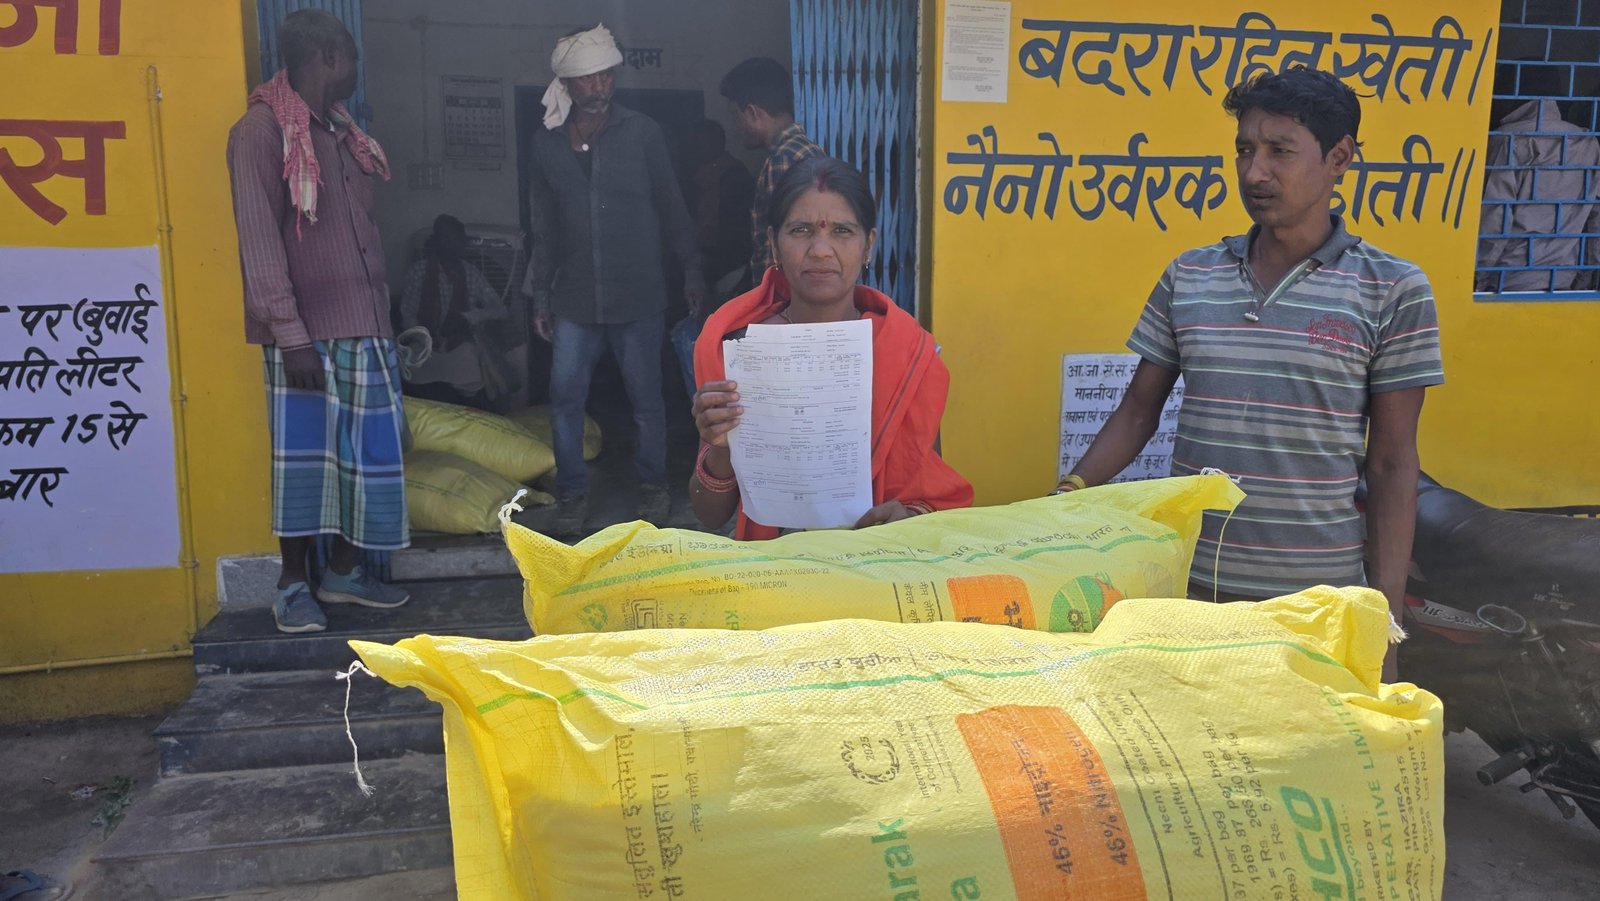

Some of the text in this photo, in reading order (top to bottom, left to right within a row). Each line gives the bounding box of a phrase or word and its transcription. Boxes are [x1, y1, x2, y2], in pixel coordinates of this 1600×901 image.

[1018, 18, 1195, 96] बदरा
[943, 125, 1073, 221] नैनो
[1069, 132, 1227, 231] उर्वरक
[17, 303, 73, 342] पर
[55, 346, 145, 396] लीटर
[61, 413, 104, 444] 15
[107, 400, 148, 450] से
[858, 735, 876, 762] 2025
[1202, 750, 1223, 778] bag
[1152, 790, 1175, 835] Neem
[1165, 771, 1205, 859] Agriculture
[1212, 810, 1230, 841] bag
[1393, 782, 1412, 851] HAZIRA
[1045, 823, 1074, 875] 46%
[1100, 814, 1129, 867] 46%
[1224, 845, 1244, 874] per
